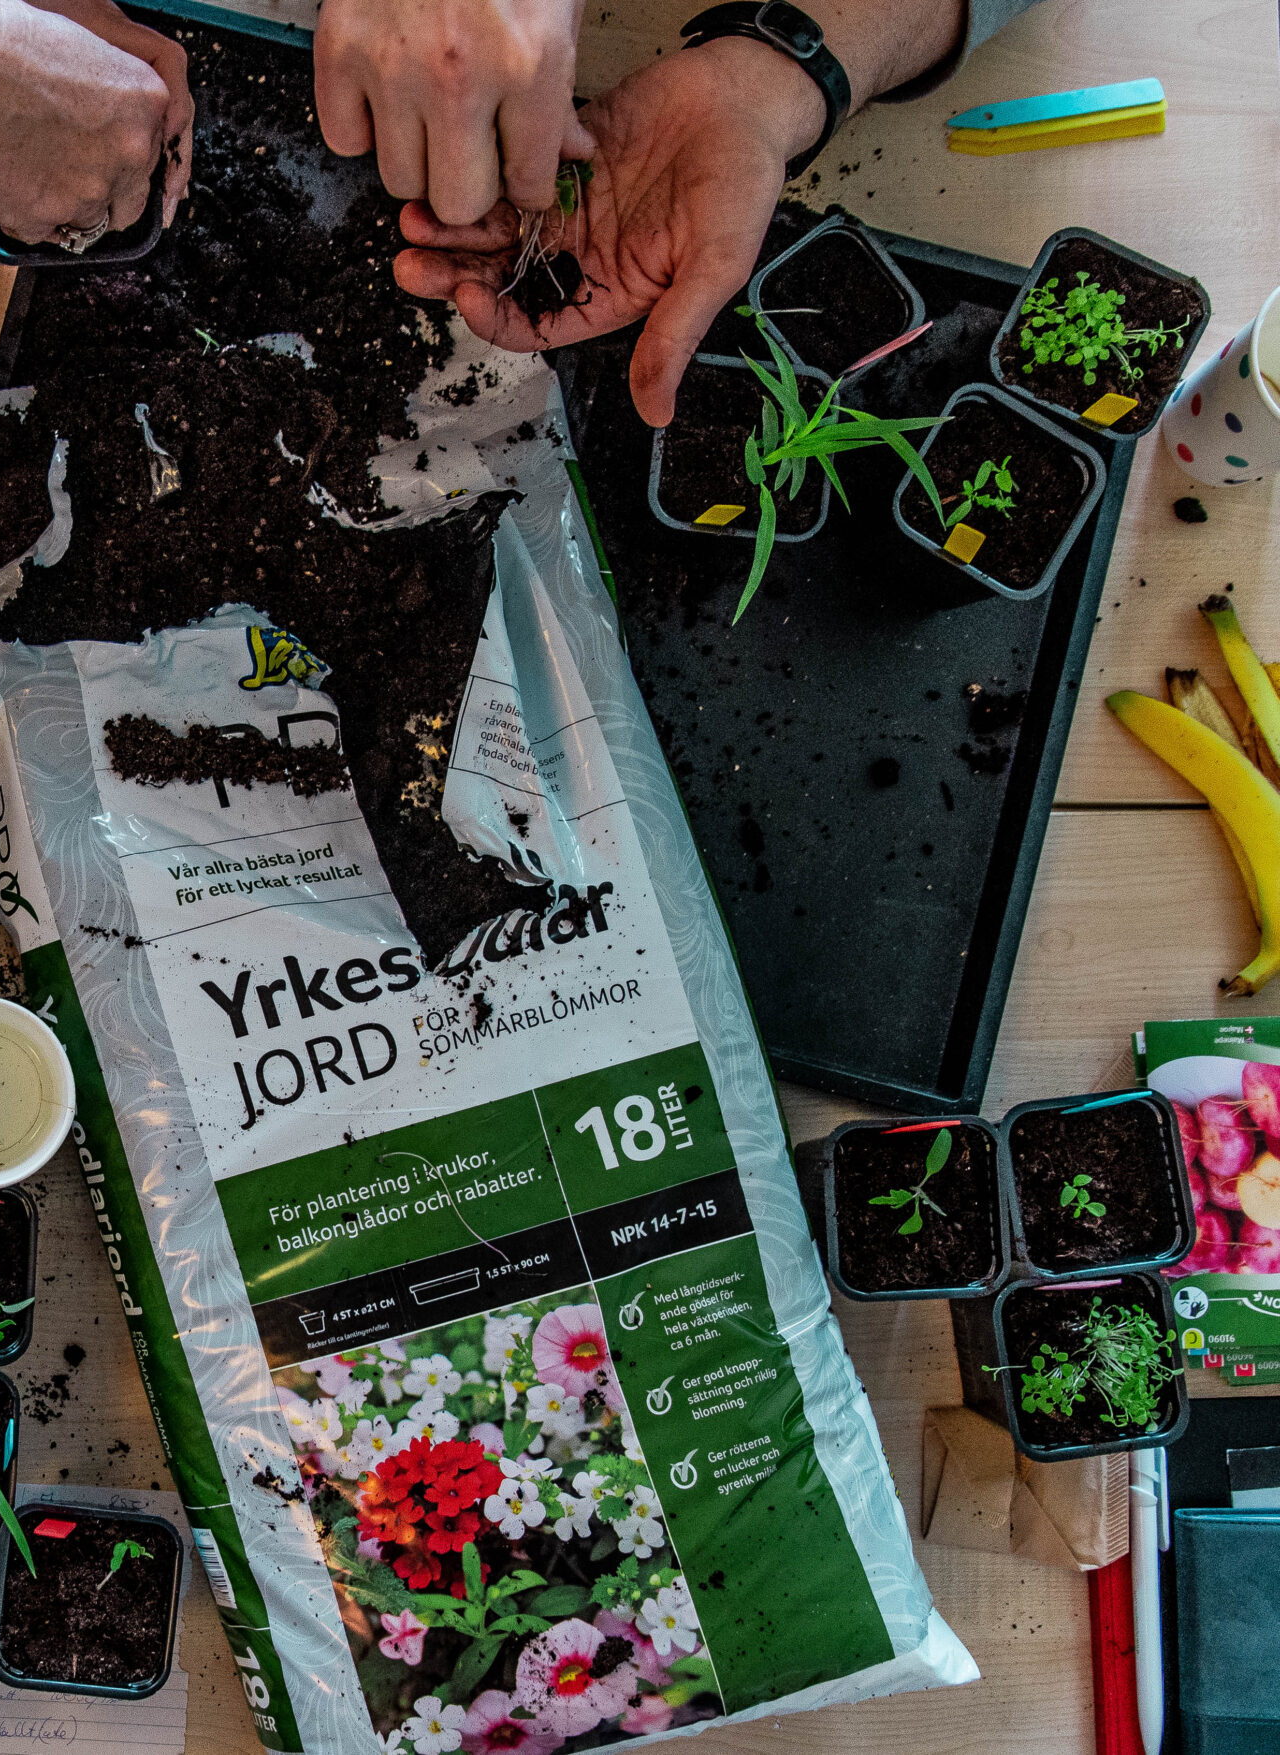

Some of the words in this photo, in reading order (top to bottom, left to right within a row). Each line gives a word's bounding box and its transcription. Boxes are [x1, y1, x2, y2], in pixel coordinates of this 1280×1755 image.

[484, 714, 524, 735] råvaror
[489, 699, 504, 712] En
[505, 703, 521, 718] bla
[480, 730, 526, 754] optimala
[510, 757, 531, 773] och
[168, 861, 200, 881] Vår
[205, 854, 243, 876] allra
[246, 851, 295, 872] bästa
[297, 843, 335, 867] jord
[175, 885, 204, 906] för
[209, 879, 234, 899] ett
[237, 874, 291, 895] lyckat
[294, 863, 363, 887] resultat
[412, 1004, 461, 1036] FÖR
[419, 978, 642, 1059] SOMMARBLOMMOR
[232, 1022, 398, 1130] JORD
[657, 1081, 694, 1150] LITER
[573, 1094, 669, 1171] 18
[36, 994, 143, 1316] Yodlarjord
[268, 1204, 304, 1227] För
[305, 1173, 410, 1222] plantering
[423, 1151, 498, 1186] krukor,
[276, 1204, 410, 1254] balkonglådor
[413, 1192, 452, 1217] och
[455, 1167, 544, 1205] rabatter.
[610, 1223, 647, 1248] NPK
[650, 1199, 719, 1233] 14-7-15
[485, 1268, 500, 1280] 1,5
[500, 1264, 513, 1275] ST
[520, 1258, 533, 1269] 90
[534, 1253, 550, 1265] CM
[653, 1290, 679, 1306] Med
[680, 1272, 745, 1298] långtidsverk-
[659, 1305, 688, 1321] ande
[689, 1295, 720, 1314] gödsel
[719, 1288, 735, 1301] för
[339, 1309, 353, 1320] ST
[379, 1297, 396, 1309] CM
[664, 1320, 689, 1336] hela
[690, 1302, 753, 1329] växtperioden,
[307, 1339, 328, 1350] Räcker
[327, 1336, 336, 1344] till
[670, 1339, 683, 1351] ca
[685, 1336, 693, 1347] 6
[695, 1328, 721, 1344] mån.
[1208, 1333, 1236, 1344] 91090
[682, 1376, 701, 1390] Ger
[704, 1368, 725, 1385] god
[725, 1357, 763, 1378] knopp-
[687, 1382, 733, 1405] sättning
[734, 1375, 752, 1390] och
[752, 1366, 778, 1387] riklig
[691, 1397, 748, 1421] blomning.
[707, 1449, 728, 1464] Ger
[729, 1434, 772, 1456] rötterna
[713, 1467, 726, 1479] en
[727, 1454, 761, 1474] lucker
[762, 1447, 780, 1462] och
[717, 1473, 755, 1495] syrerik
[234, 1646, 270, 1710] 18
[251, 1712, 278, 1733] ITER
